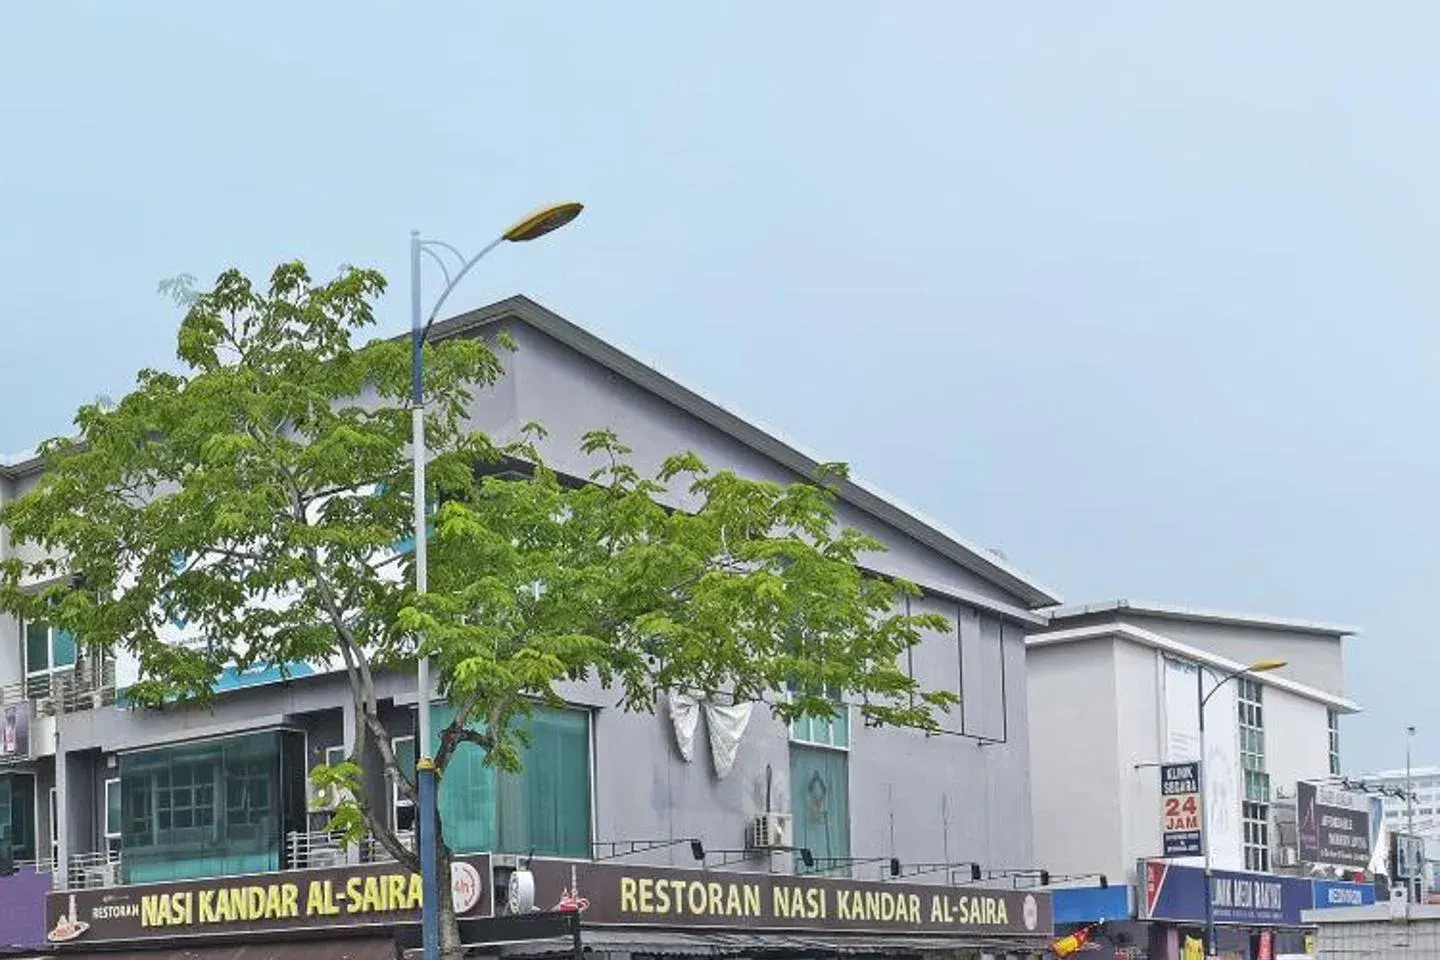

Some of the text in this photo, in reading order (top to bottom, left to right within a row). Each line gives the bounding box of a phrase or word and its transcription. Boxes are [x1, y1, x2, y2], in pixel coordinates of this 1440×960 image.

[1165, 796, 1197, 817] 24
[1167, 816, 1199, 830] JAM
[92, 873, 424, 927] RESTORAN NASI KANDAR AL-SAIRA
[621, 877, 1009, 925] RESTORAN NASI KANDAR AL-SAIRA
